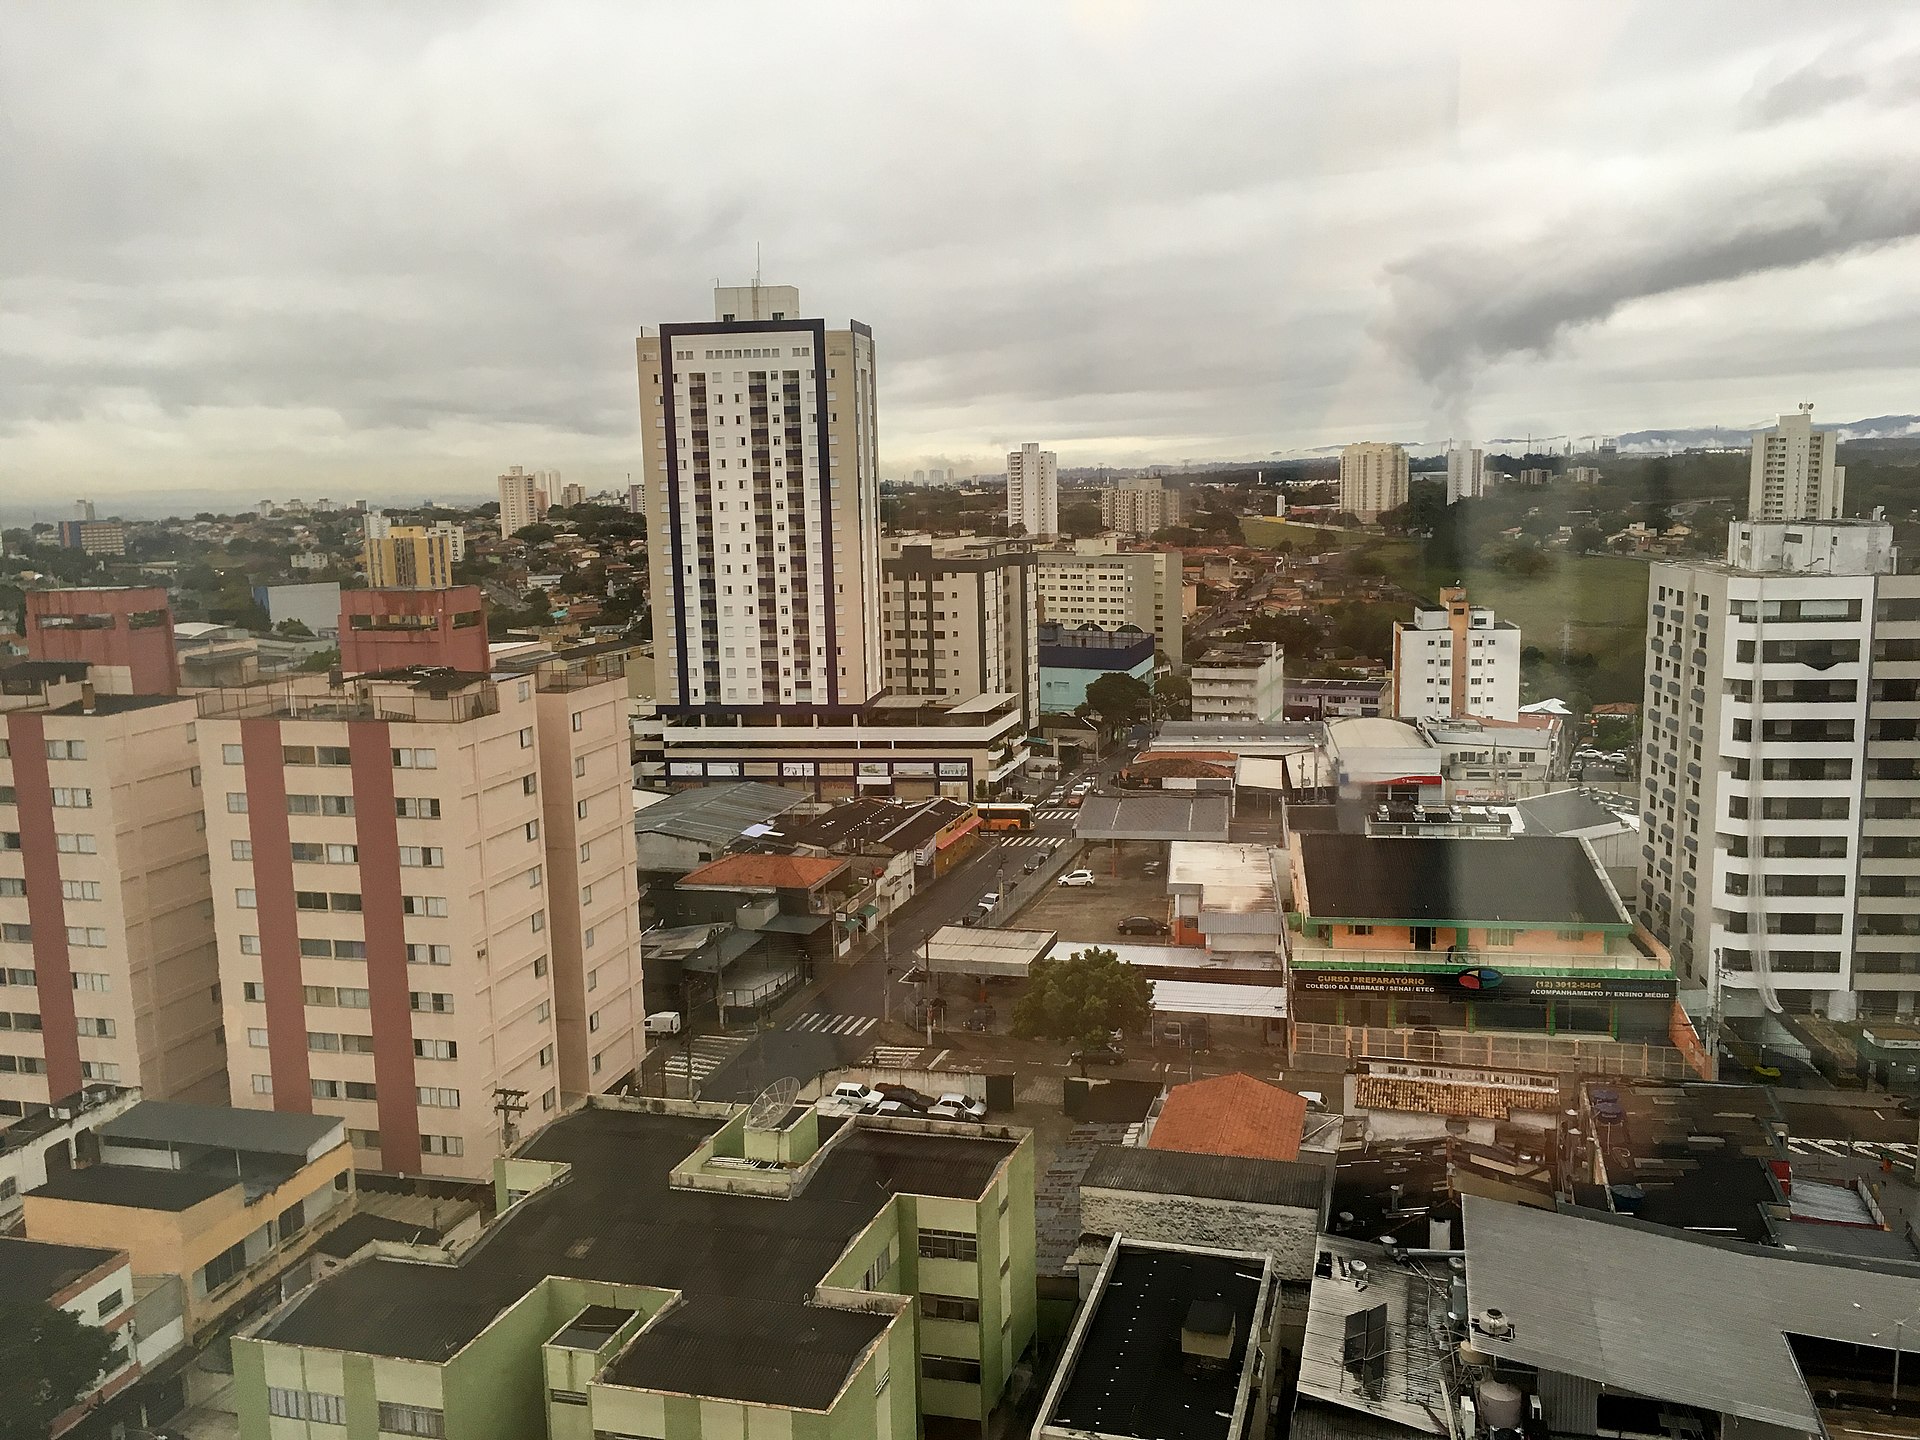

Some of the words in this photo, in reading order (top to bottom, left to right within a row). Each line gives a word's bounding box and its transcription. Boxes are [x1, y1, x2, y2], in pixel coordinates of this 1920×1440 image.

[1317, 975, 1350, 983] CURSO
[1352, 975, 1425, 985] PREPARATÓRIO
[1535, 980, 1553, 989] (12)
[1530, 989, 1604, 997] ACOMPANHAMENTO
